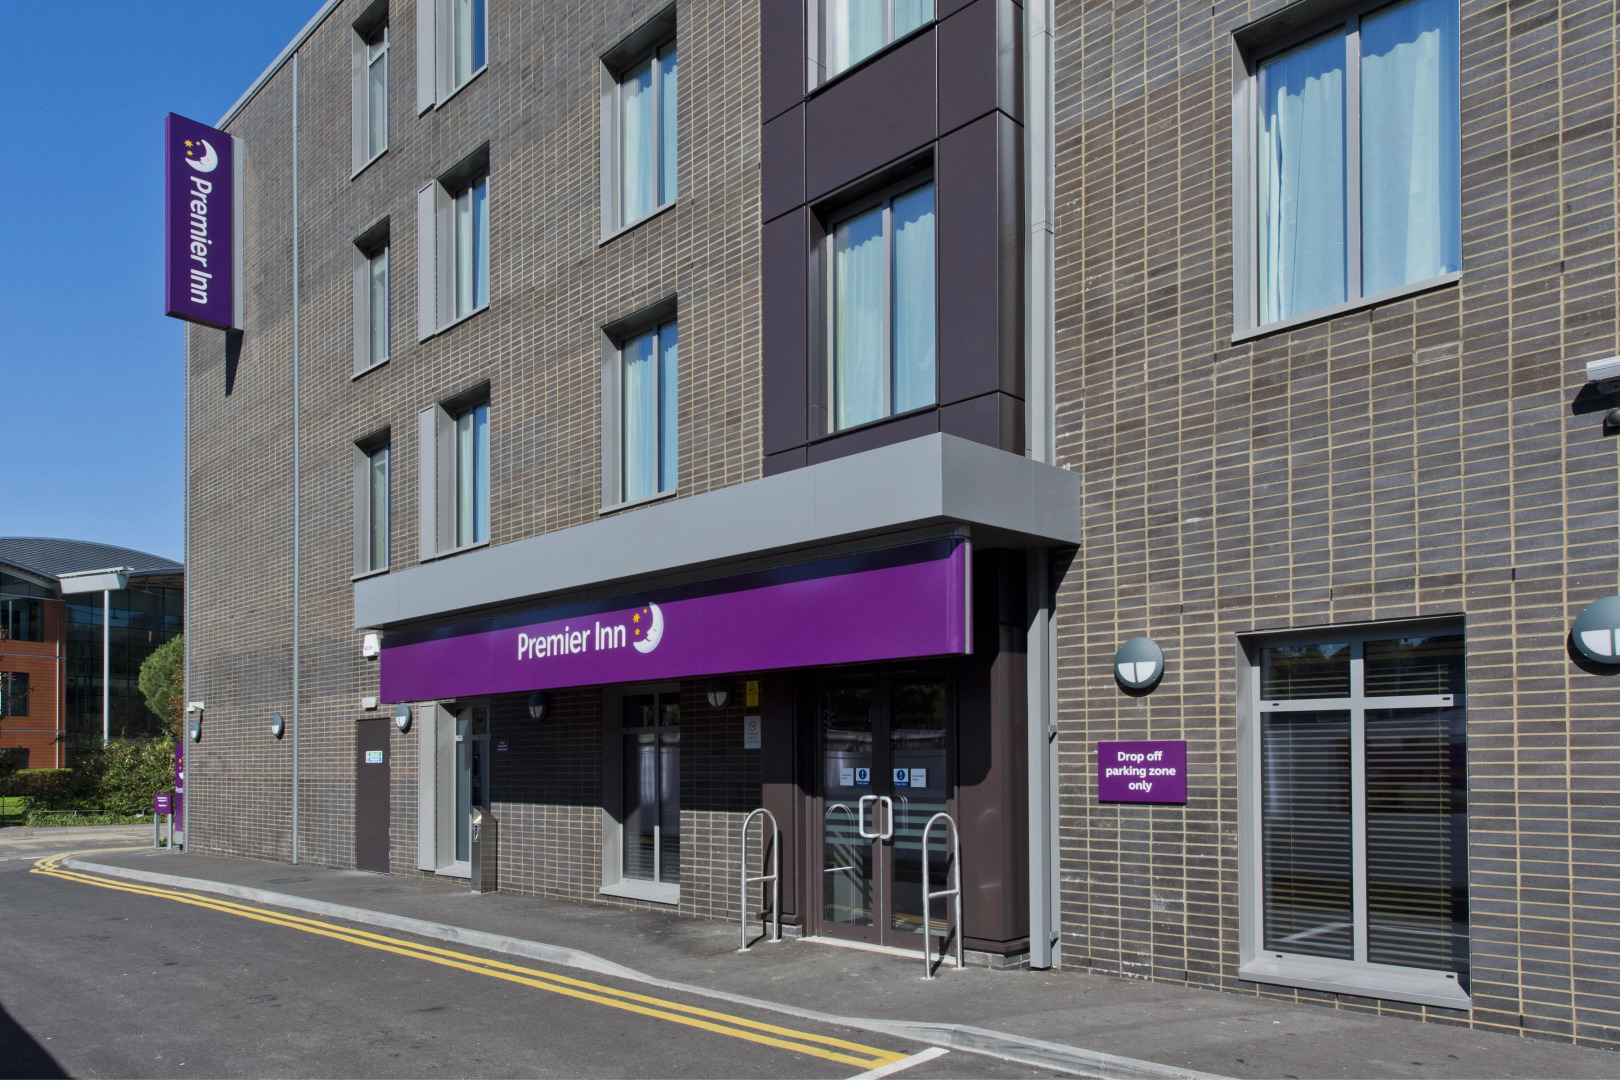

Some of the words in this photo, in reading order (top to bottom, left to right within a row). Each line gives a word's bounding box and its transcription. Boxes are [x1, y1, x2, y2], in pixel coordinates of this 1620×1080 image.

[190, 175, 213, 267] Premier
[190, 268, 213, 305] Inn
[517, 625, 591, 661] Premier
[595, 621, 626, 651] Inn
[1117, 751, 1145, 764] Drop
[1146, 750, 1163, 761] off
[1105, 765, 1147, 778] parking
[1148, 767, 1177, 776] zone
[1128, 780, 1153, 793] only
